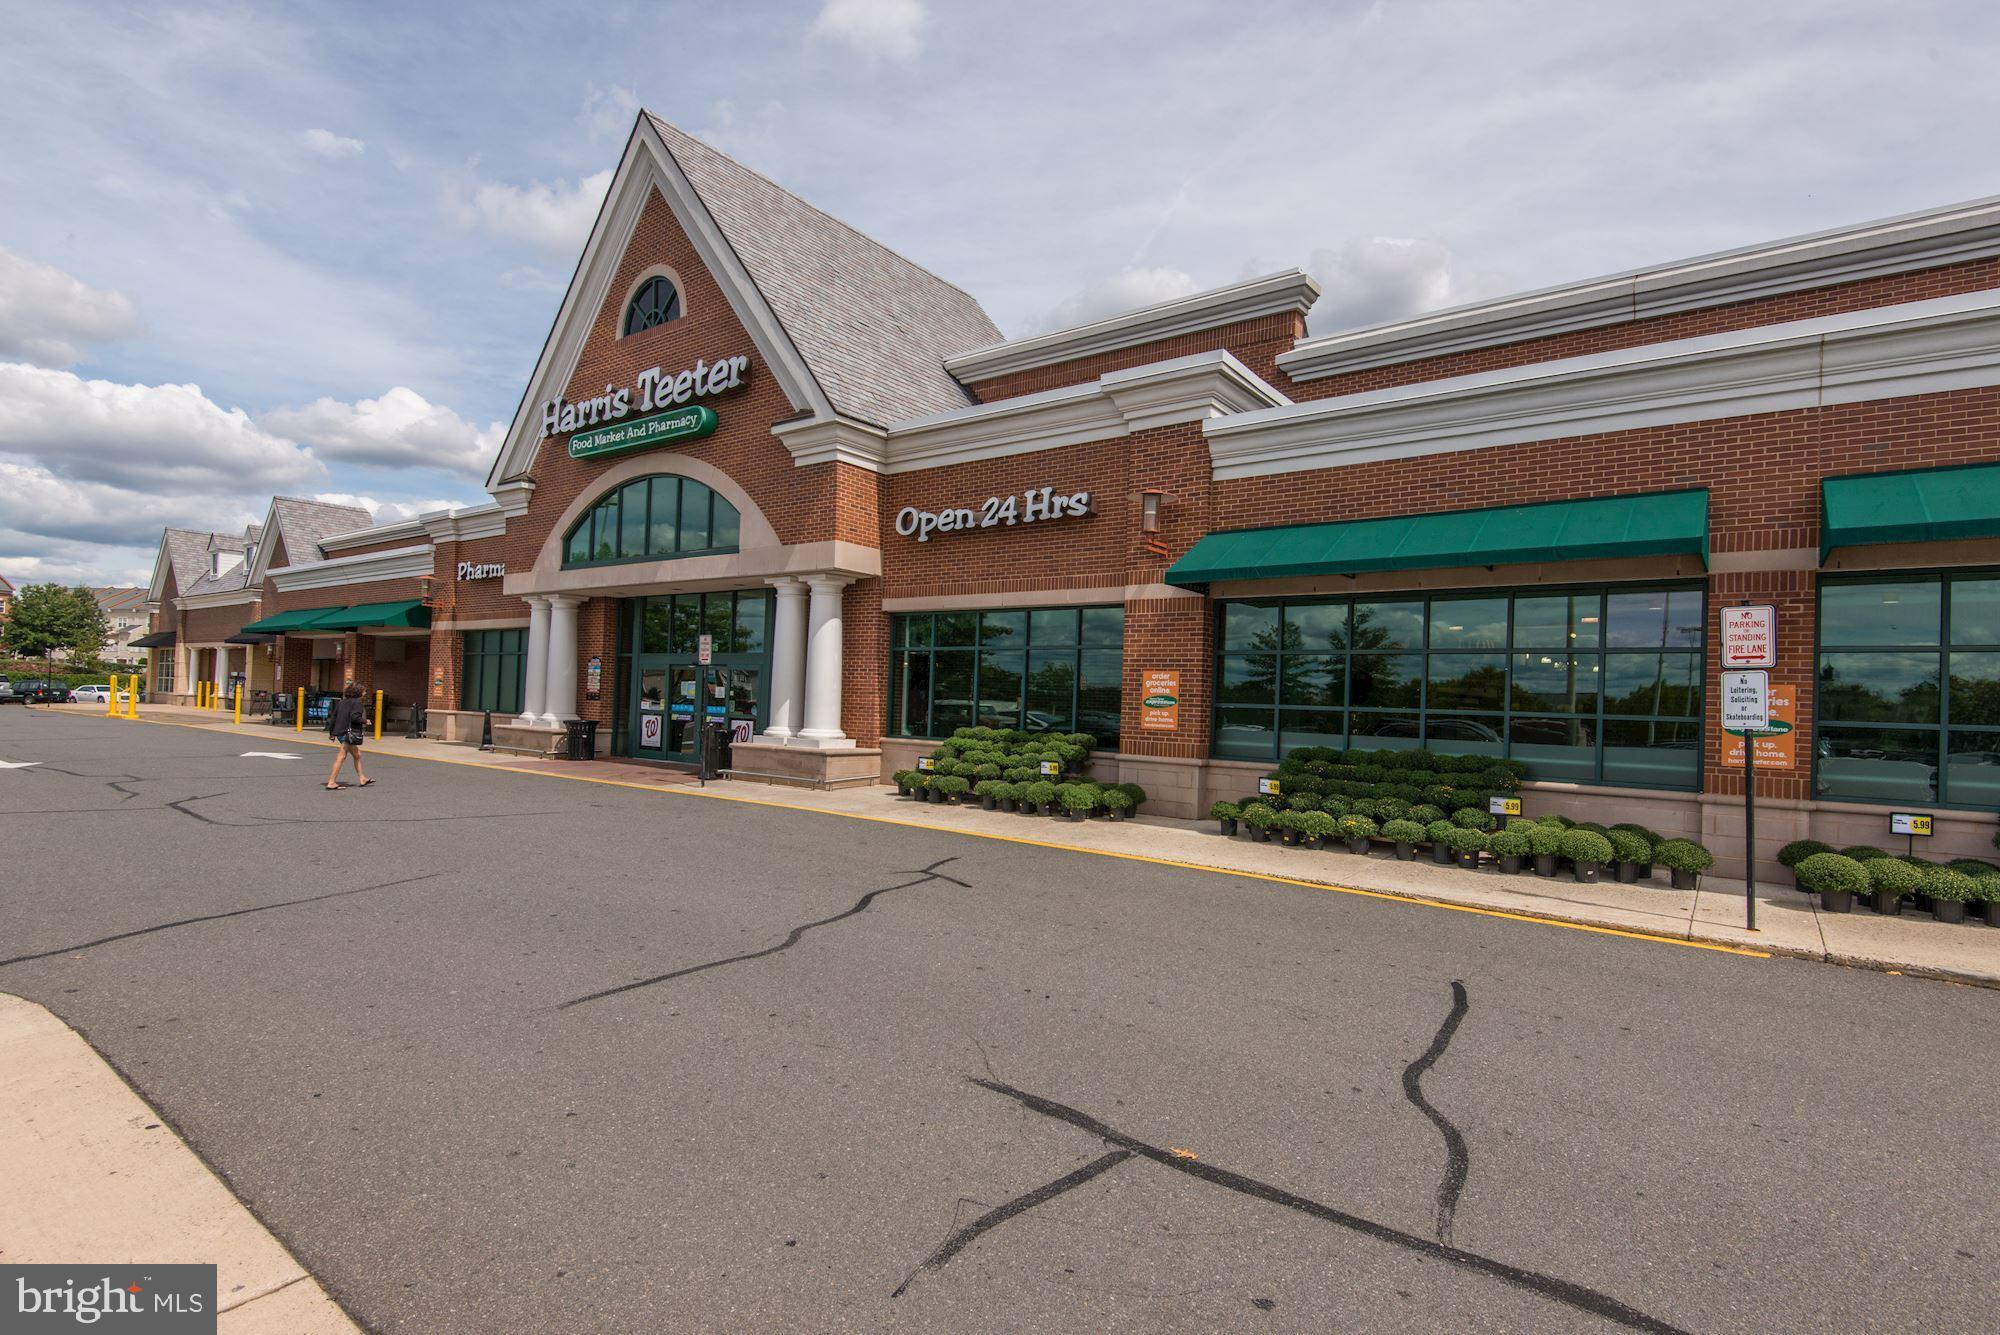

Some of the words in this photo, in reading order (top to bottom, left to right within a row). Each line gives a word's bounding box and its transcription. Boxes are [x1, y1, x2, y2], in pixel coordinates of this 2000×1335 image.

[540, 383, 630, 438] Harris
[638, 355, 747, 411] Teeter
[572, 439, 592, 450] Food
[594, 430, 624, 446] Market
[626, 424, 646, 438] And
[648, 414, 697, 434] Pharmacy
[896, 507, 975, 542] Open
[981, 495, 1018, 528] 24
[1023, 486, 1089, 523] Hrs
[1741, 612, 1753, 620] NO
[1728, 645, 1745, 654] FIRE
[1747, 644, 1767, 653] LANE
[1730, 686, 1758, 694] Loitering,
[1730, 696, 1758, 704] Soliciting
[1726, 713, 1763, 721] Skateboarding
[646, 718, 659, 738] W
[1738, 740, 1760, 749] pk
[1756, 749, 1787, 758] home.
[1728, 757, 1788, 766] harrieter.com
[1505, 802, 1519, 810] 5.99
[1913, 820, 1930, 829] 5.99
